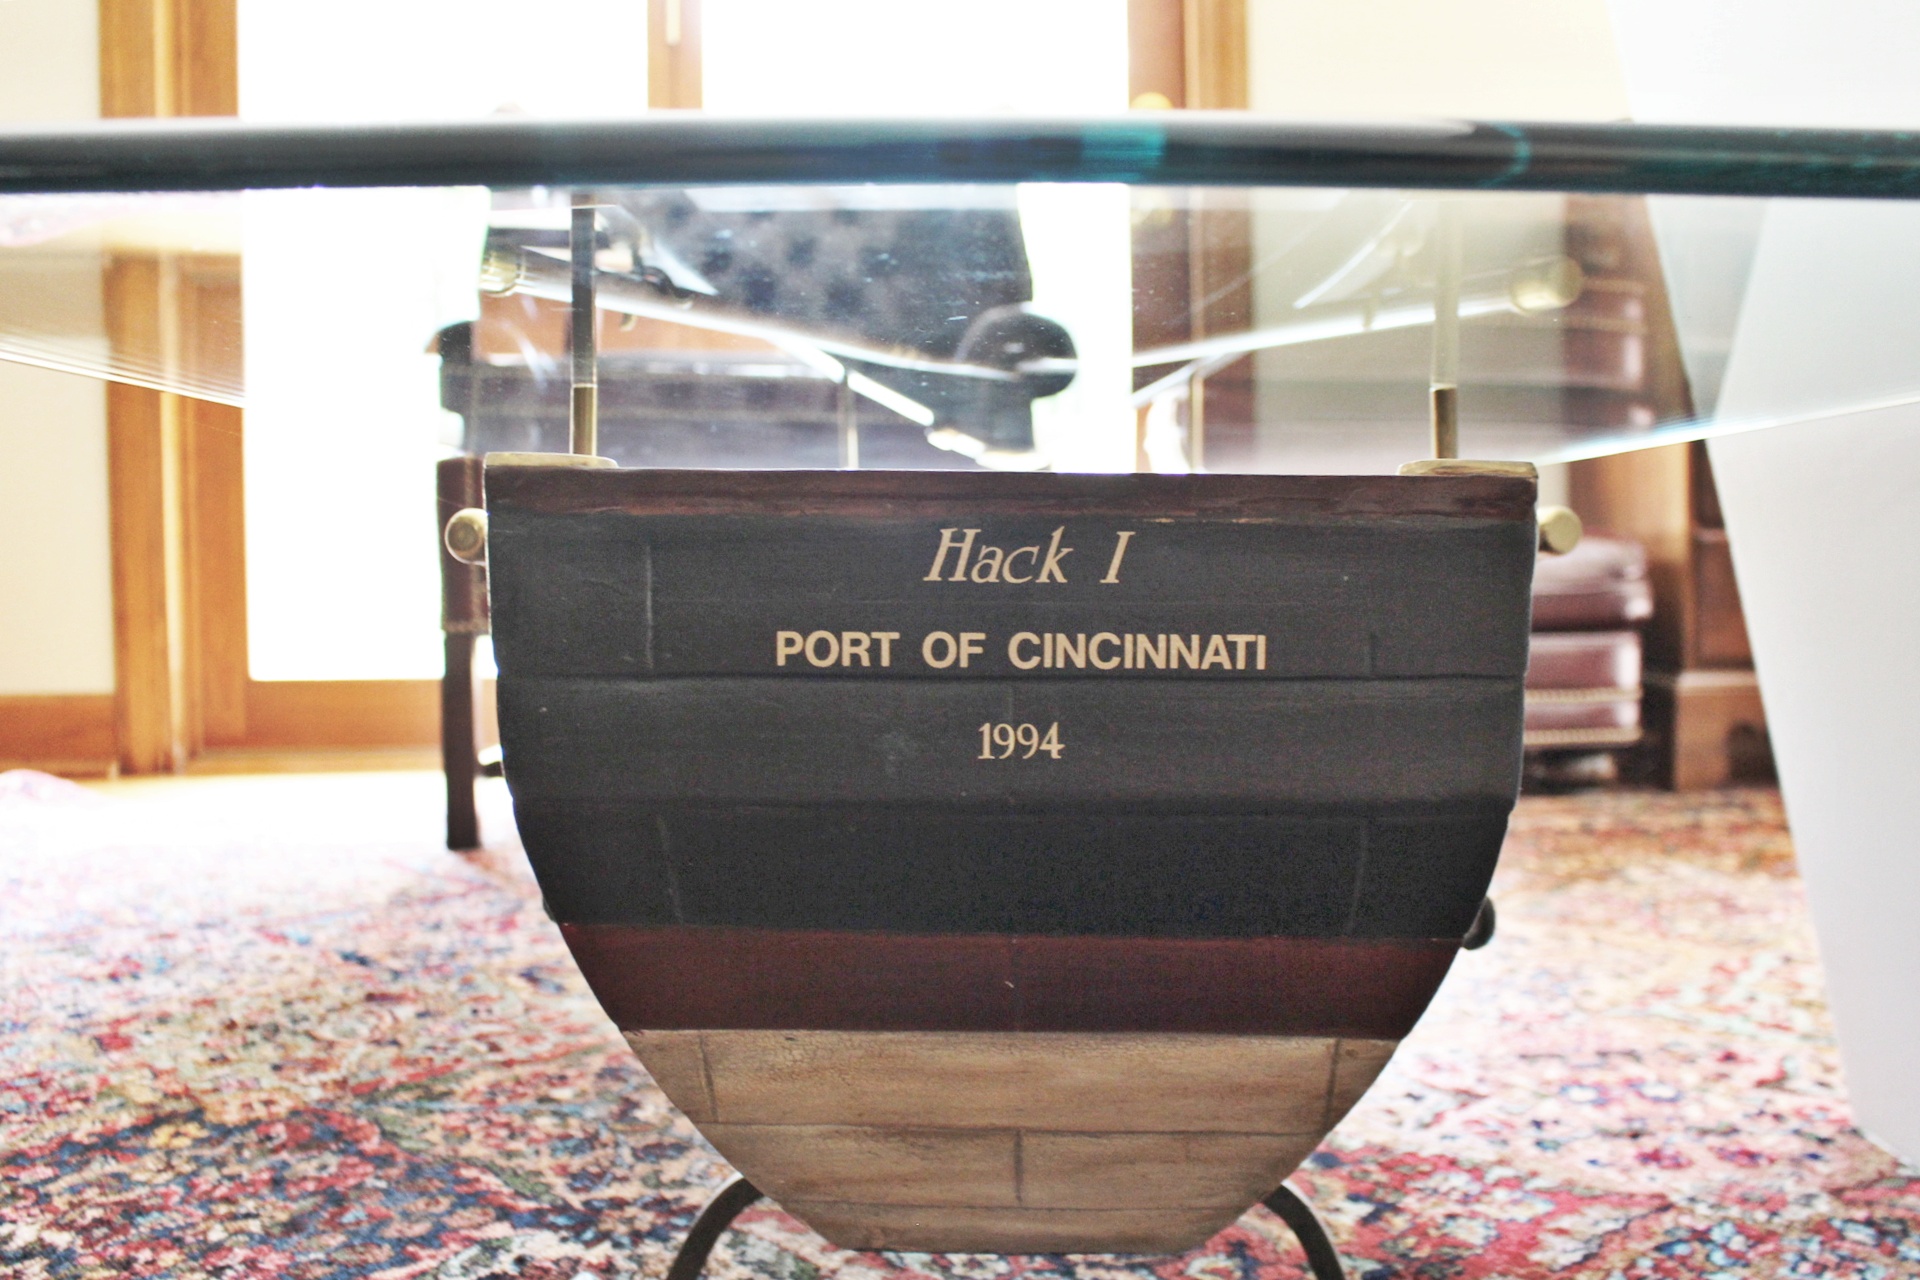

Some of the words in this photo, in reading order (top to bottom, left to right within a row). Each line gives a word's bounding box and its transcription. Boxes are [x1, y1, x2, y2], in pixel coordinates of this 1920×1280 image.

[922, 525, 1074, 584] Hack
[1099, 530, 1136, 584] I
[776, 629, 900, 668] PORT
[921, 630, 987, 669] OF
[1007, 631, 1267, 671] CINCINNATI
[977, 721, 1066, 760] 1994
